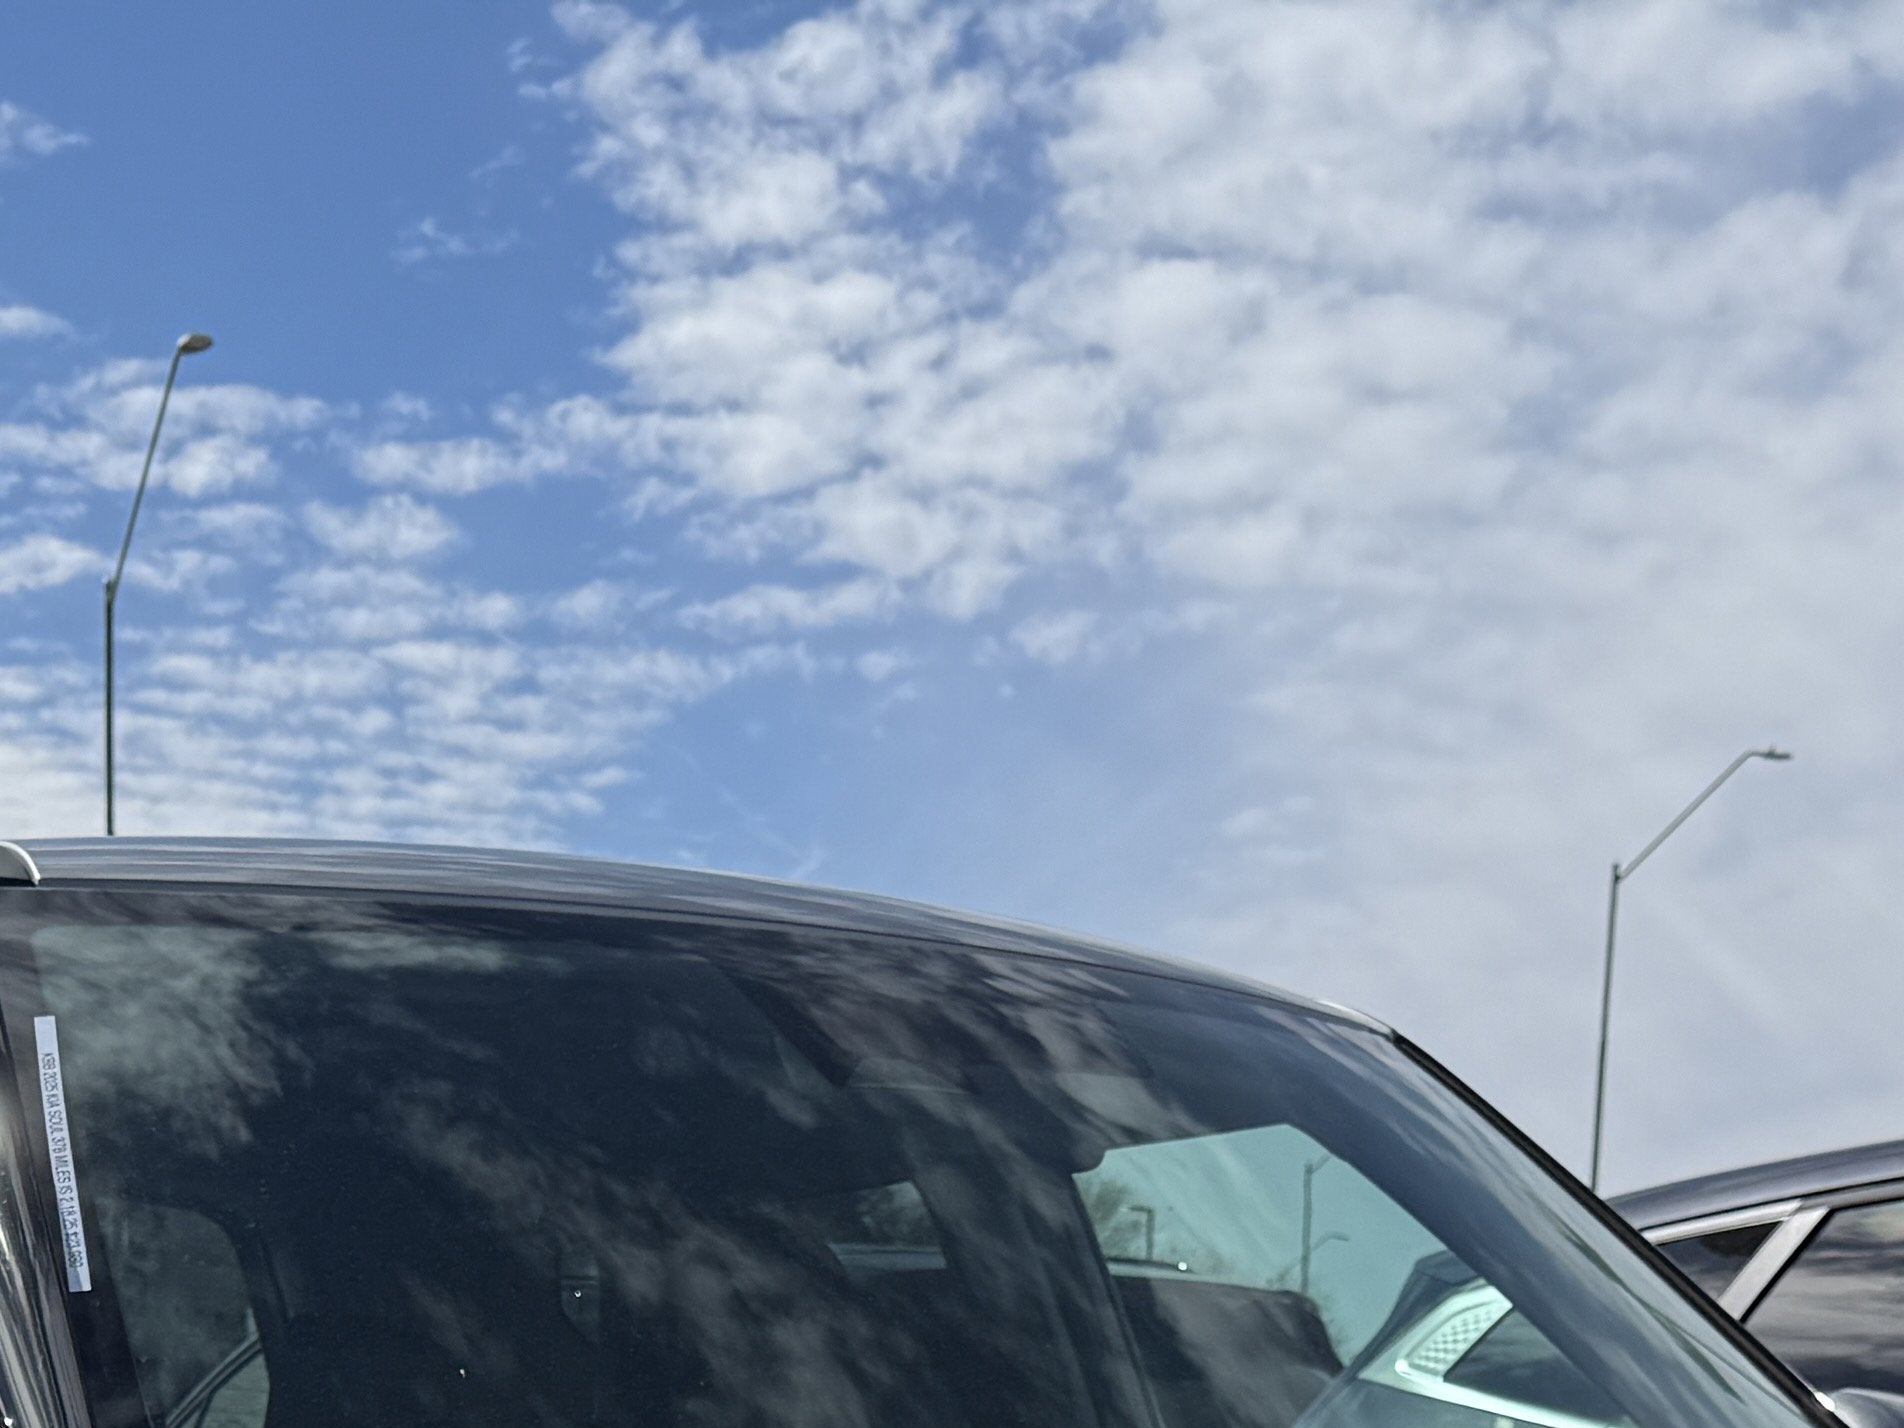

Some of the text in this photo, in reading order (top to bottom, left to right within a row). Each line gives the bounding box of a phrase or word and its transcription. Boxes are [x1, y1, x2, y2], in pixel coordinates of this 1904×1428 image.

[44, 1071, 58, 1091] 2025
[46, 1093, 61, 1108] KIA
[49, 1109, 64, 1134] SOUL
[55, 1154, 71, 1183] MILES
